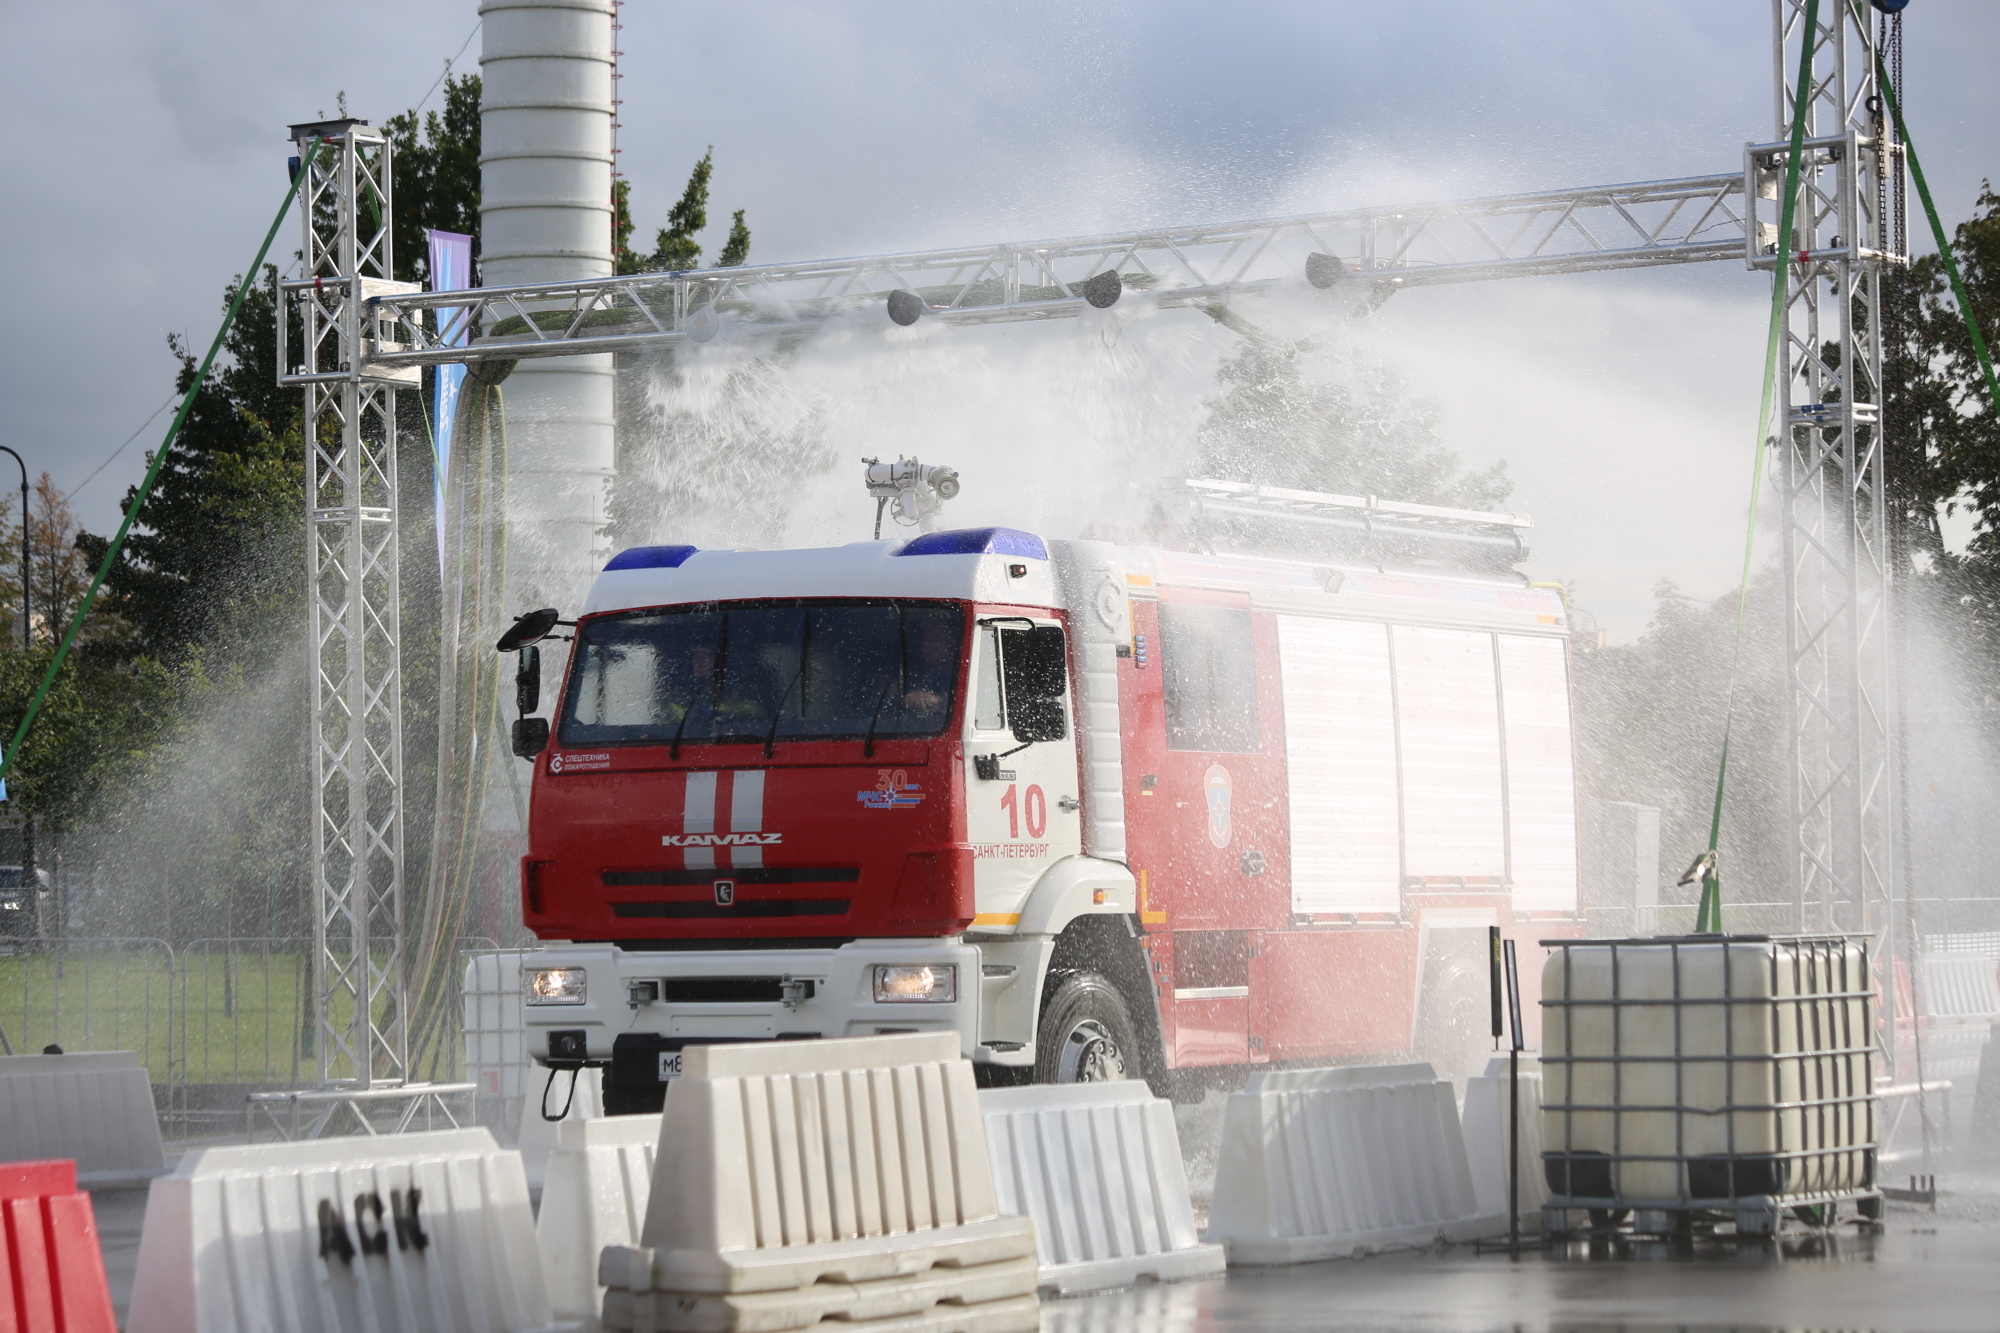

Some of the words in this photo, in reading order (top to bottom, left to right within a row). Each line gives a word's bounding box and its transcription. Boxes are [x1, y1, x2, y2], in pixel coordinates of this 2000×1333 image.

[565, 753, 610, 762] СПЕЦТЕХНИКА
[876, 769, 907, 791] 30
[857, 791, 883, 802] МЧС
[1001, 783, 1047, 839] 10
[662, 833, 782, 846] KAMAZ
[974, 844, 1049, 860] САНКТ-ПЕТЕРБУРГ
